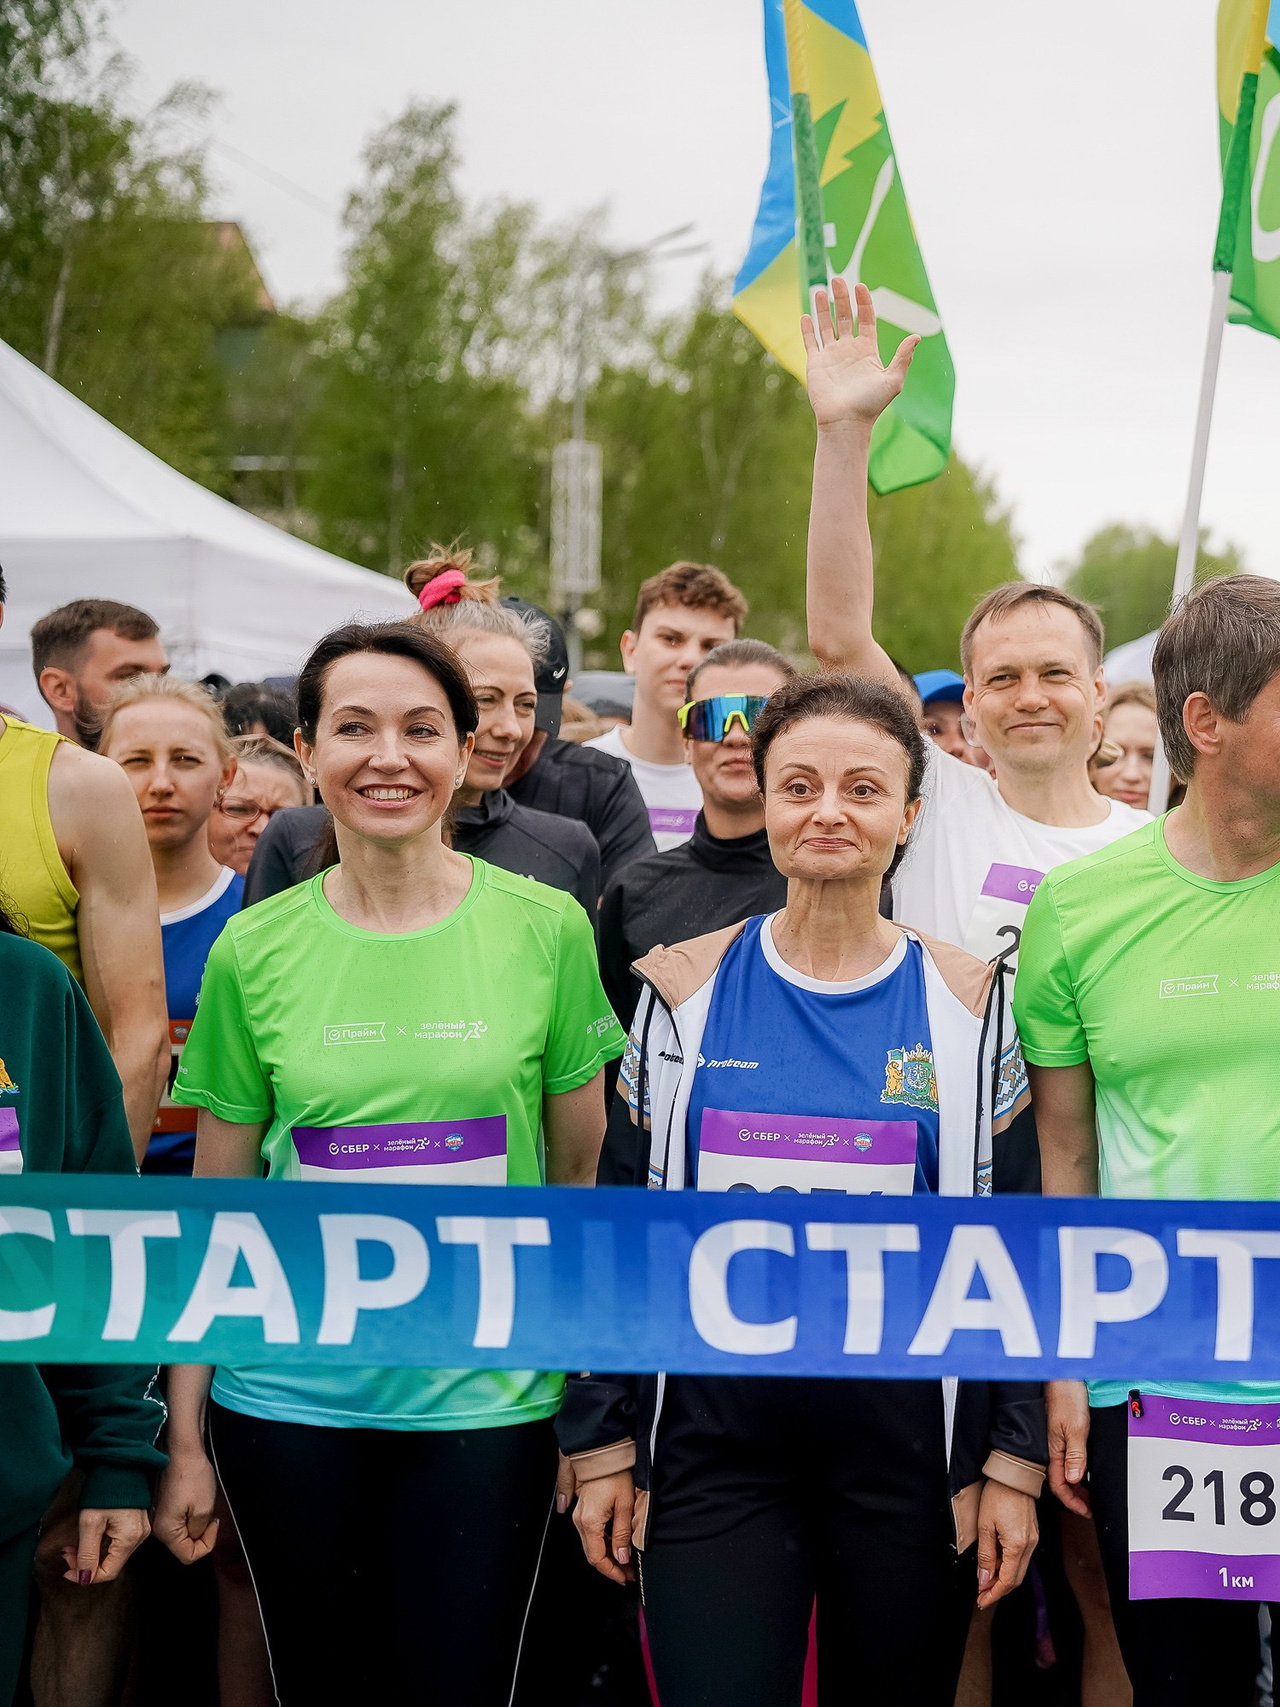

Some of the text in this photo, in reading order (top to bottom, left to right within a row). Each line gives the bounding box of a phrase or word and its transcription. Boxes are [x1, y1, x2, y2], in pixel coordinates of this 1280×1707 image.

[1176, 980, 1210, 992] Прайм
[420, 1020, 466, 1030] зелёный
[342, 1028, 377, 1039] Прайм
[414, 1030, 462, 1040] марафон
[706, 1058, 760, 1070] proteam
[752, 1131, 781, 1141] СБЕР
[341, 1144, 370, 1153] СБЕР
[1182, 1415, 1207, 1426] СБЕР
